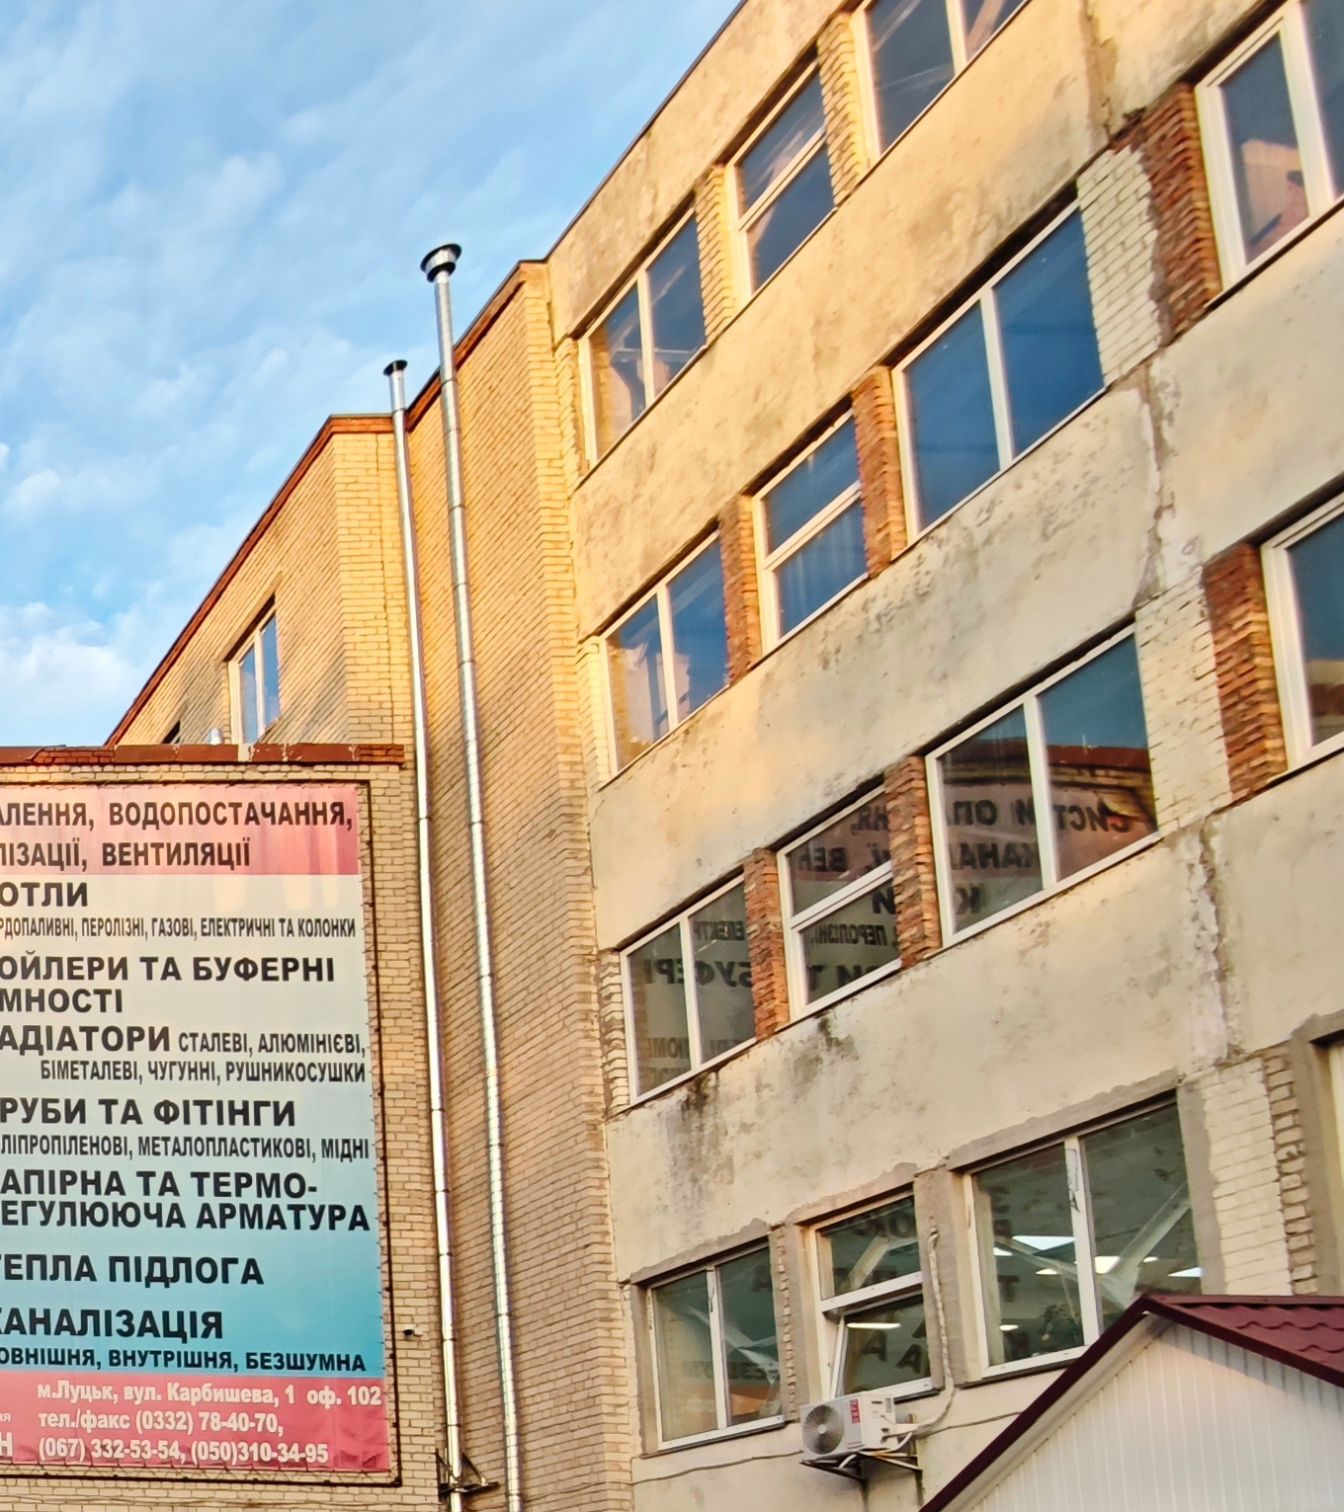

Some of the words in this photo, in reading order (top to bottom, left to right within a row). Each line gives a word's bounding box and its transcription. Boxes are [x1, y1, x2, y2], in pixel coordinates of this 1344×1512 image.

[109, 800, 353, 831] ВОДОПОСТАЧАННЯ,
[102, 838, 251, 871] ВЕНТИЛЯЦІЇ
[81, 917, 148, 940] ПЕРОЛІЗНІ,
[151, 917, 197, 941] ГАЗОВІ,
[201, 917, 275, 939] ЕЛЕКТРИЧНІ
[279, 918, 295, 938] ТА
[298, 918, 357, 939] КОЛОНКИ
[139, 956, 183, 981] ТА
[193, 956, 336, 983] БУФЕРНІ
[179, 1032, 254, 1057] СТАЛЕВІ,
[258, 1033, 366, 1057] АЛЮМІНІЄВІ,
[40, 1060, 144, 1085] БІМЕТАЛЕВІ,
[148, 1060, 222, 1085] ЧУГУННІ,
[226, 1061, 366, 1084] РУШНИКОСУШКИ
[98, 1098, 143, 1125] ТА
[153, 1098, 296, 1127] ФІТІНГИ
[138, 1136, 316, 1162] МЕТАЛОПЛАСТИКОВІ,
[321, 1139, 370, 1163] МІДНІ
[137, 1170, 184, 1197] ТА
[191, 1171, 318, 1199] ТЕРМО-
[196, 1203, 371, 1233] АРМАТУРА
[108, 1255, 265, 1289] ПІДЛОГА
[109, 1349, 239, 1374] ВНУТРІШНЯ,
[245, 1350, 367, 1373] БЕЗШУМНА
[37, 1379, 118, 1405] м.Луцьк,
[123, 1386, 162, 1404] вул.
[167, 1381, 280, 1408] Карбишева,
[285, 1385, 295, 1404] 1
[307, 1385, 341, 1410] оф.
[347, 1385, 382, 1406] 102
[38, 1410, 130, 1435] тел./факс
[135, 1411, 194, 1435] (0332)
[198, 1412, 284, 1436] 78-40-70,
[38, 1438, 86, 1462] (067)
[91, 1439, 186, 1463] 332-53-54,
[190, 1441, 329, 1466] (050)310-34-95
